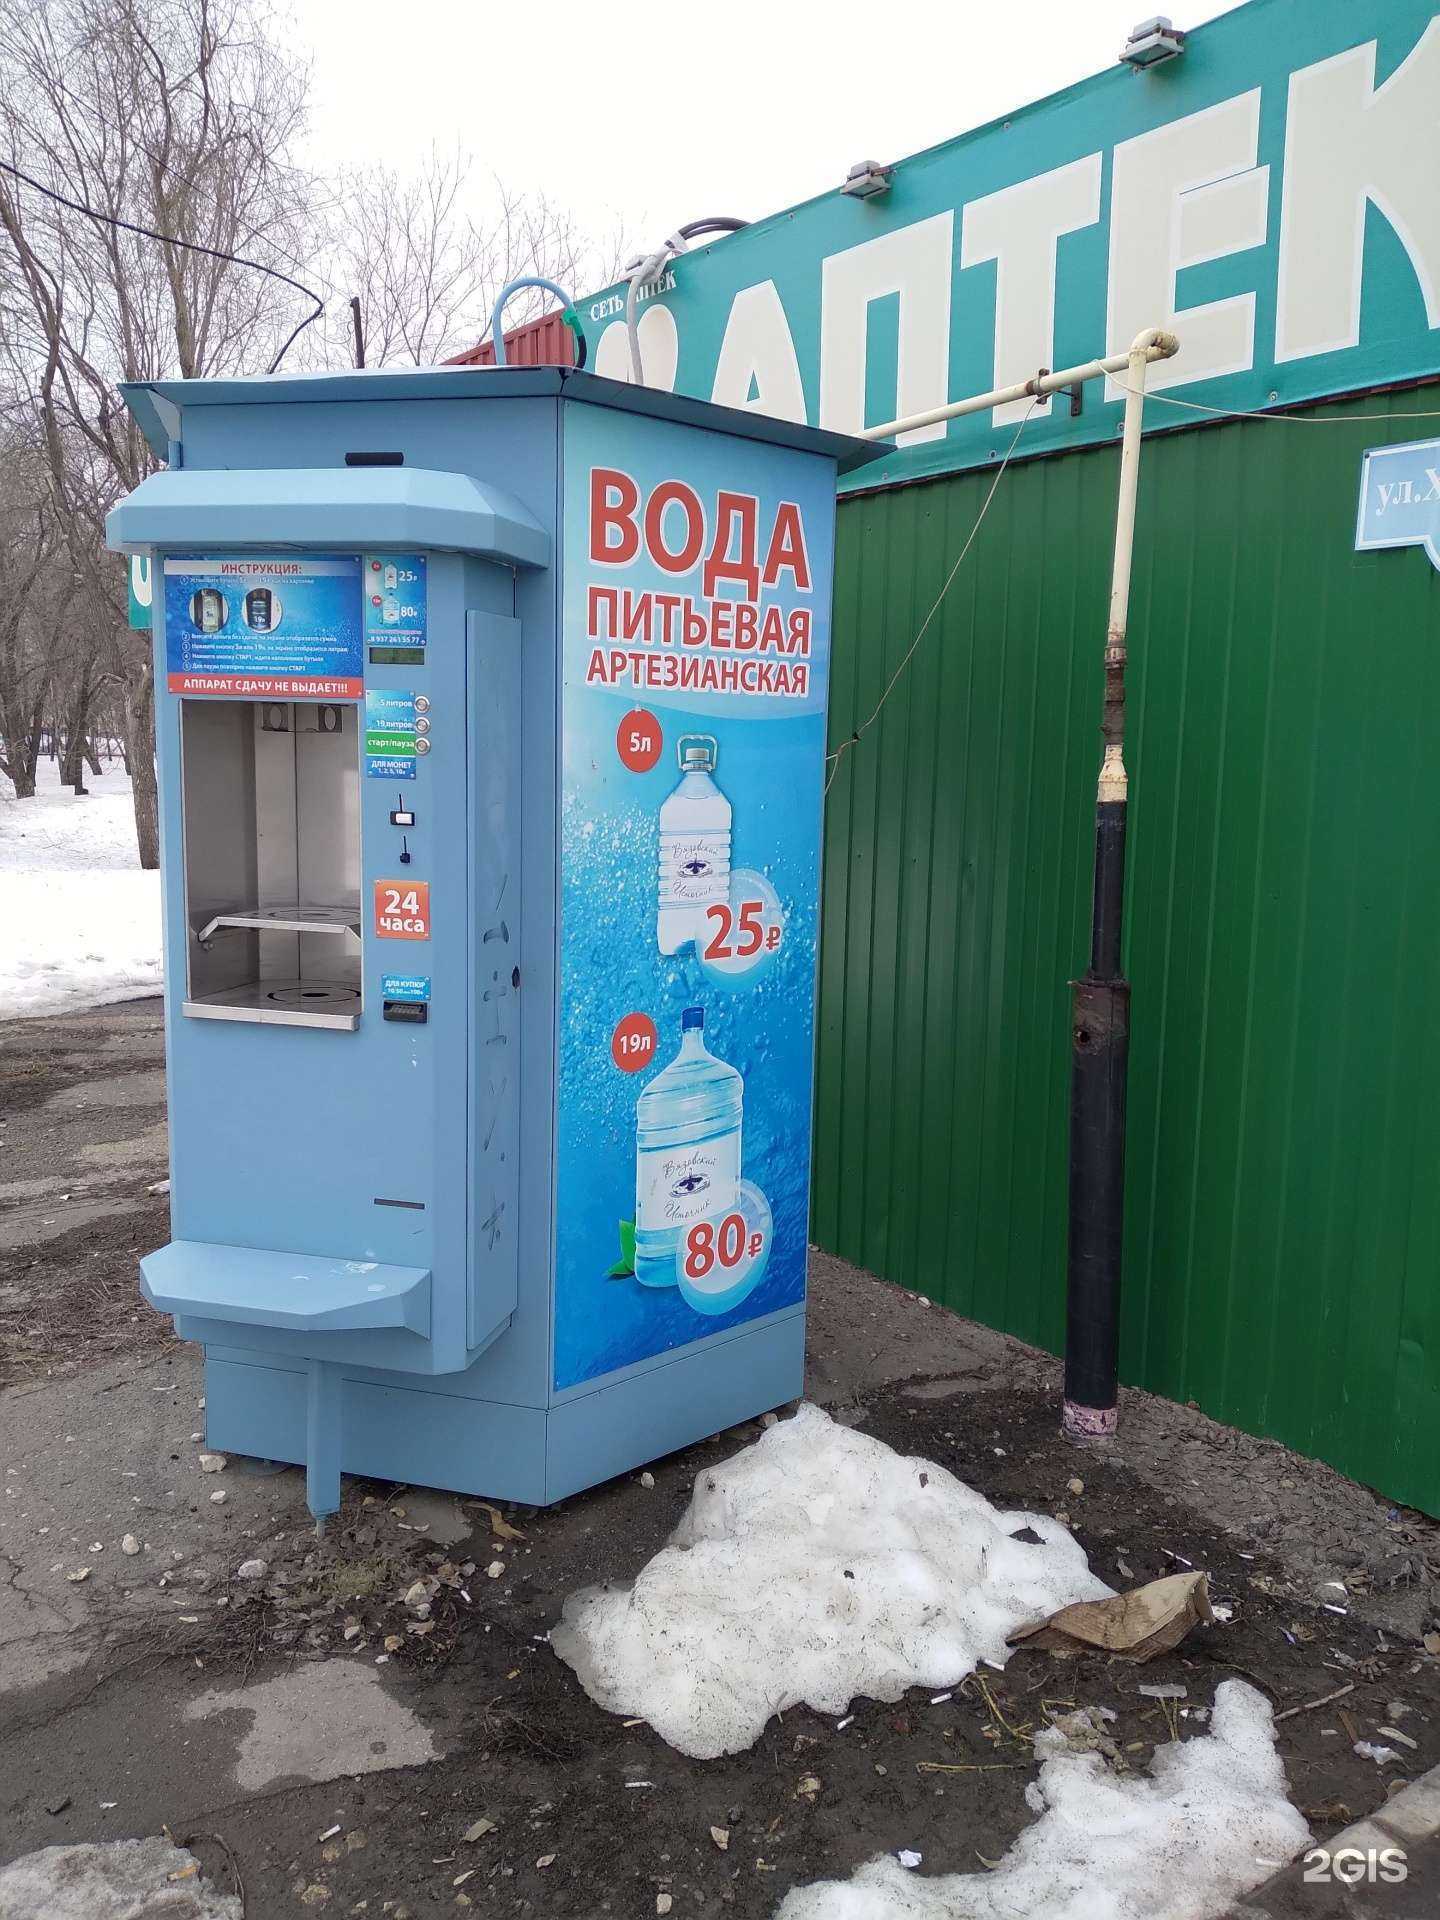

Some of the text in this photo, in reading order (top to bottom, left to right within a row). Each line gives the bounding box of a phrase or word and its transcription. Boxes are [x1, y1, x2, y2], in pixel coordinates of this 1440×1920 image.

[590, 270, 677, 321] СЕТЬ ПТЕК
[590, 467, 811, 602] ВОДА
[221, 563, 302, 575] ИНСТРУКЦИЯ:
[588, 586, 811, 655] ПИТЬЕВАЯ
[586, 649, 808, 694] АРТЕЗИАНСКАЯ
[183, 678, 348, 693] АППАРАТ СДАЧУ НЕ ВЫДАЕТ!!!
[385, 700, 413, 709] литров
[385, 721, 413, 729] литров
[367, 739, 415, 749] старт/пауза
[629, 732, 651, 752] 5л
[371, 760, 412, 769] ДЛЯ МОНЕТ
[384, 889, 420, 915] 24
[379, 917, 425, 933] часа
[619, 1033, 651, 1055] 19л
